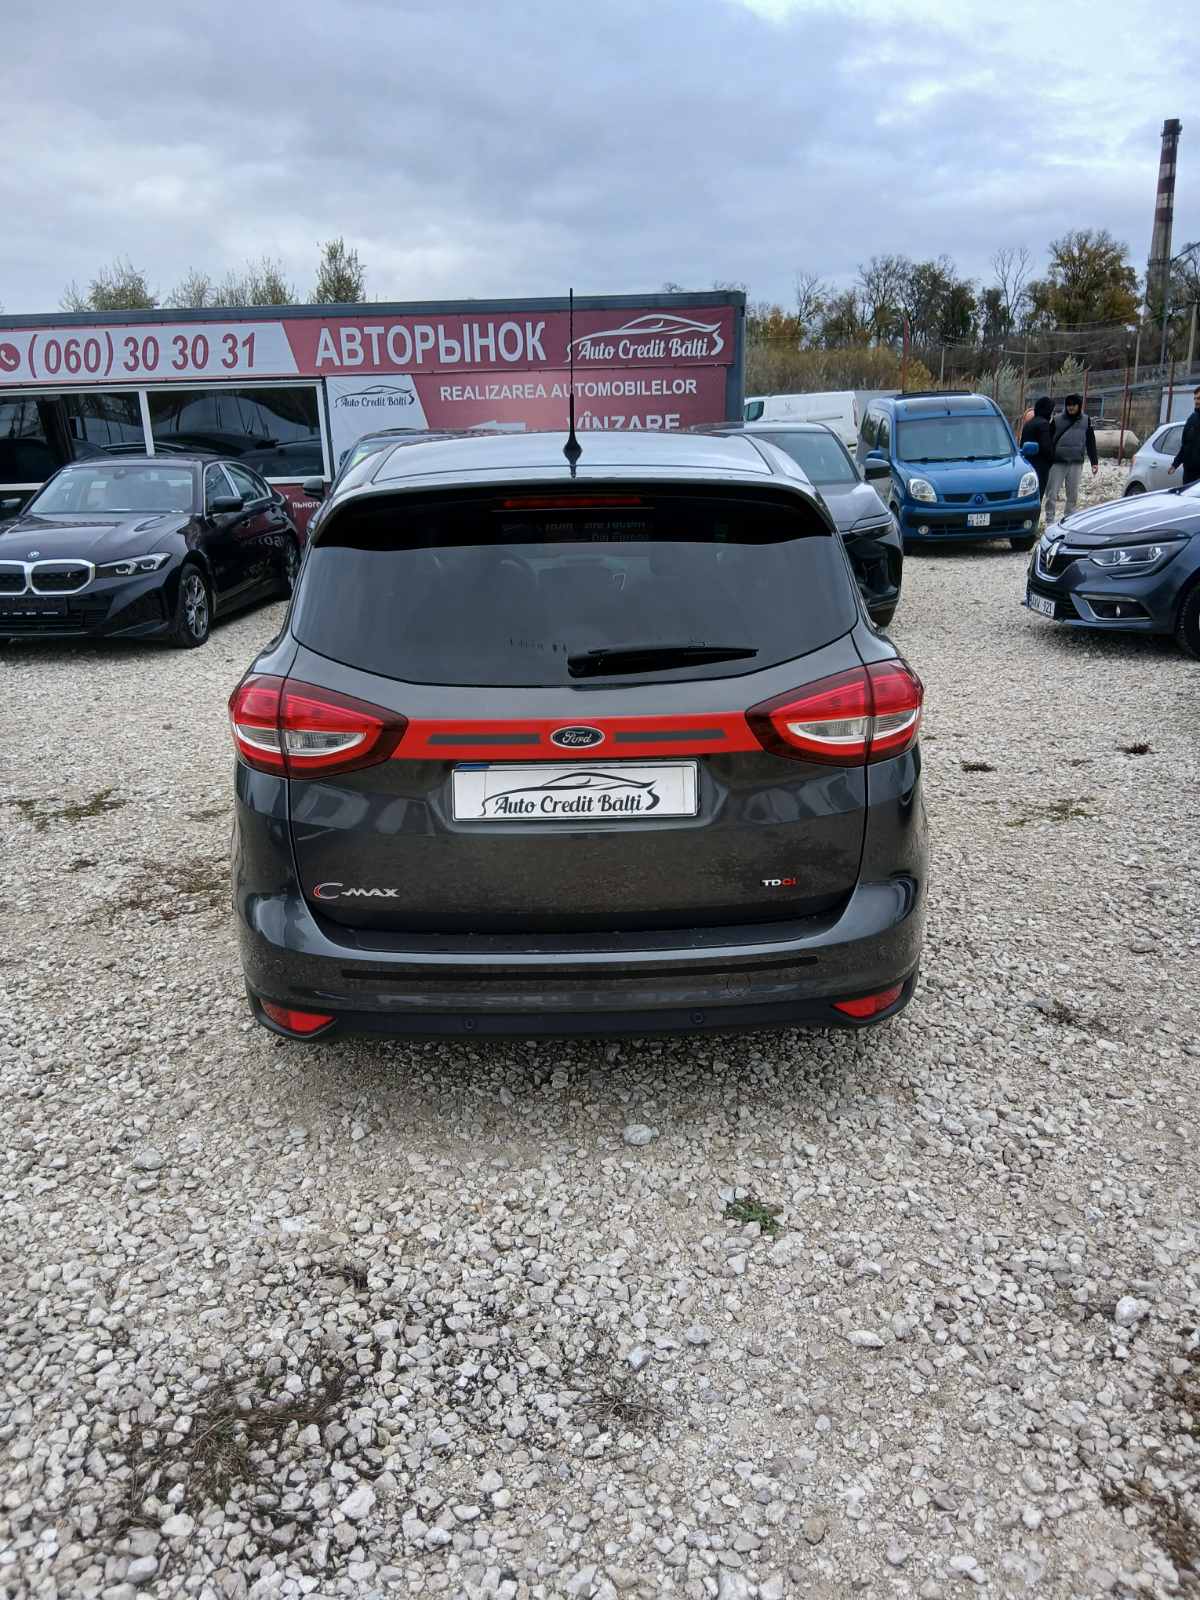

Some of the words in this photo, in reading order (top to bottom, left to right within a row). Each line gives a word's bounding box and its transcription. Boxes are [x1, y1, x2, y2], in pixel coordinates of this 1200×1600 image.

[28, 331, 113, 378] (060)
[123, 336, 160, 372] 30
[172, 334, 209, 370] 30
[221, 332, 256, 369] 31
[315, 321, 547, 367] АВТОРЫНОК
[577, 340, 616, 361] Auto
[618, 339, 666, 360] Credit
[440, 384, 547, 402] REALIZAREA
[551, 379, 697, 399] AUTOMOBILELOR
[494, 796, 537, 815] Auto
[540, 795, 594, 814] Credit
